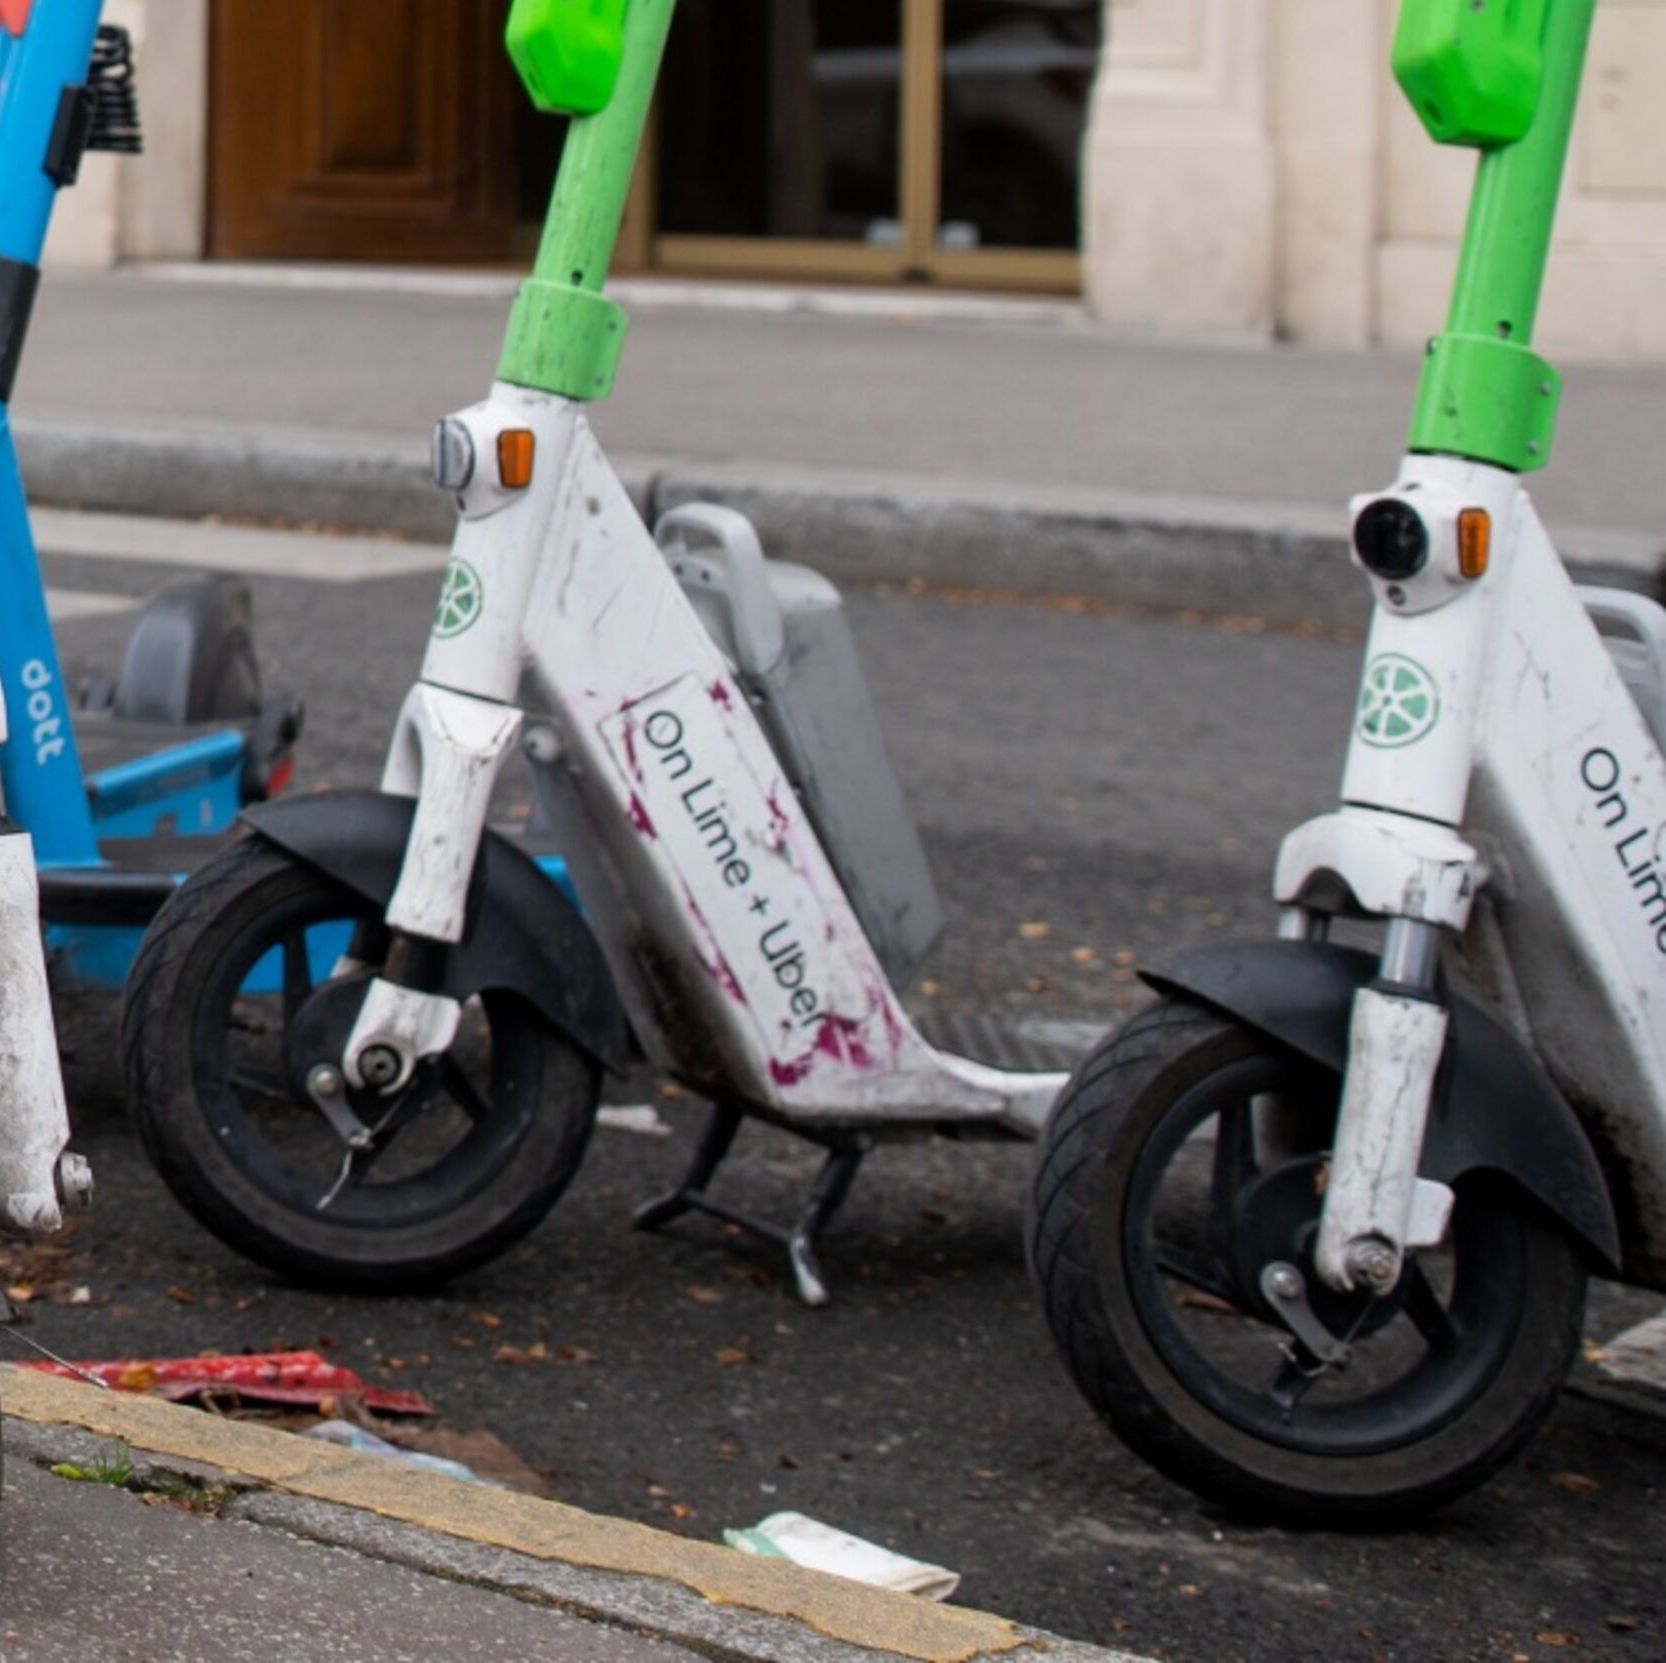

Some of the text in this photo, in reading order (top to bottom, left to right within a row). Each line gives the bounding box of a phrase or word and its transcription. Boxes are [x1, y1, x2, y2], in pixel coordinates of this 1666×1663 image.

[21, 658, 65, 766] dott
[1581, 747, 1628, 829] On
[644, 710, 828, 1029] On Lime + Uber
